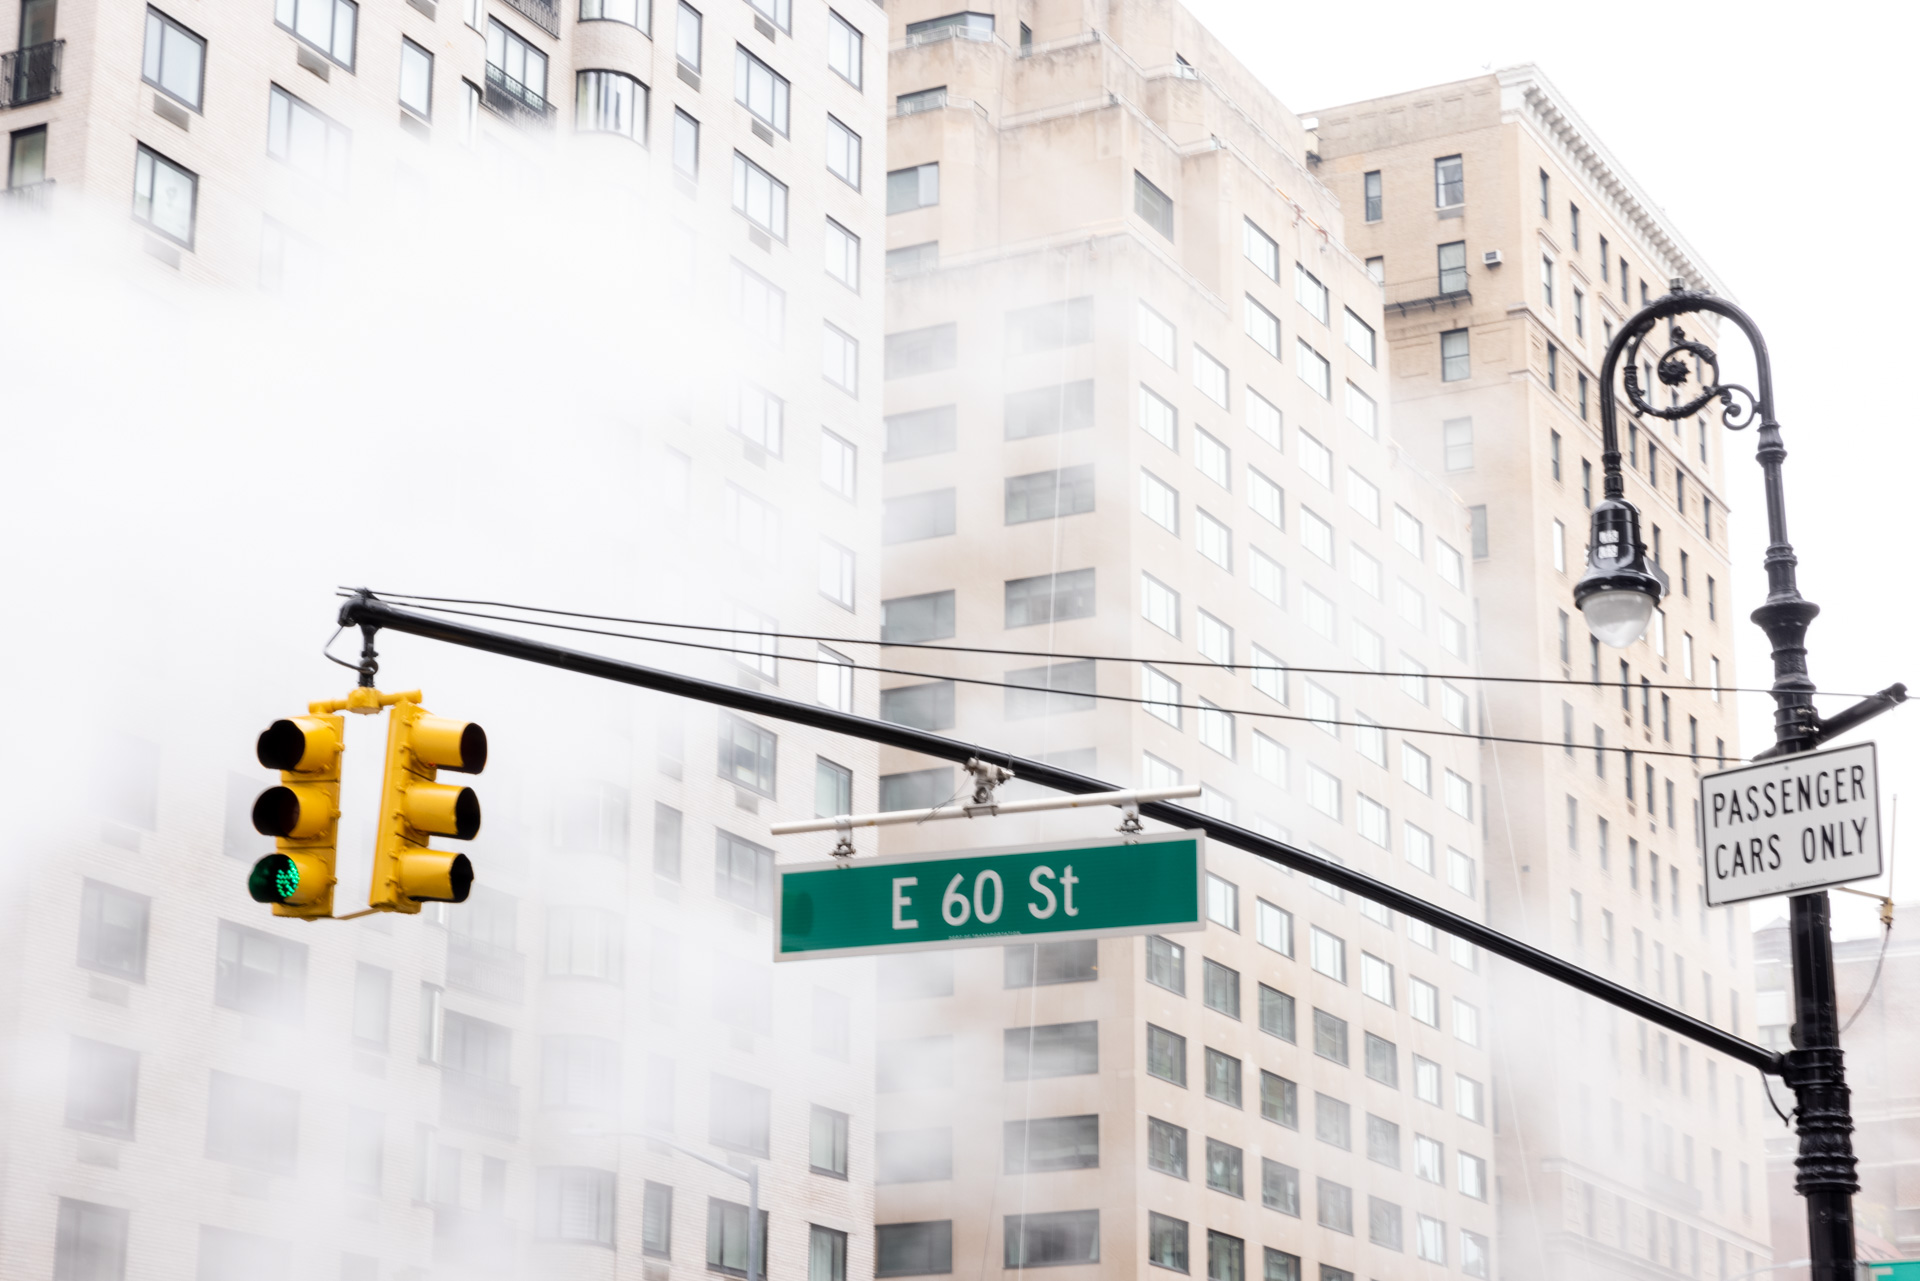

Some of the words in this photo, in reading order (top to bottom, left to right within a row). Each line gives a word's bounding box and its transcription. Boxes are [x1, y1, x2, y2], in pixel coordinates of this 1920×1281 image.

[1713, 765, 1866, 828] PASSENGER
[1715, 834, 1781, 880] CARS
[1802, 817, 1867, 864] ONLY
[892, 876, 918, 930] E
[941, 869, 1004, 926] 60
[1028, 864, 1079, 920] St
